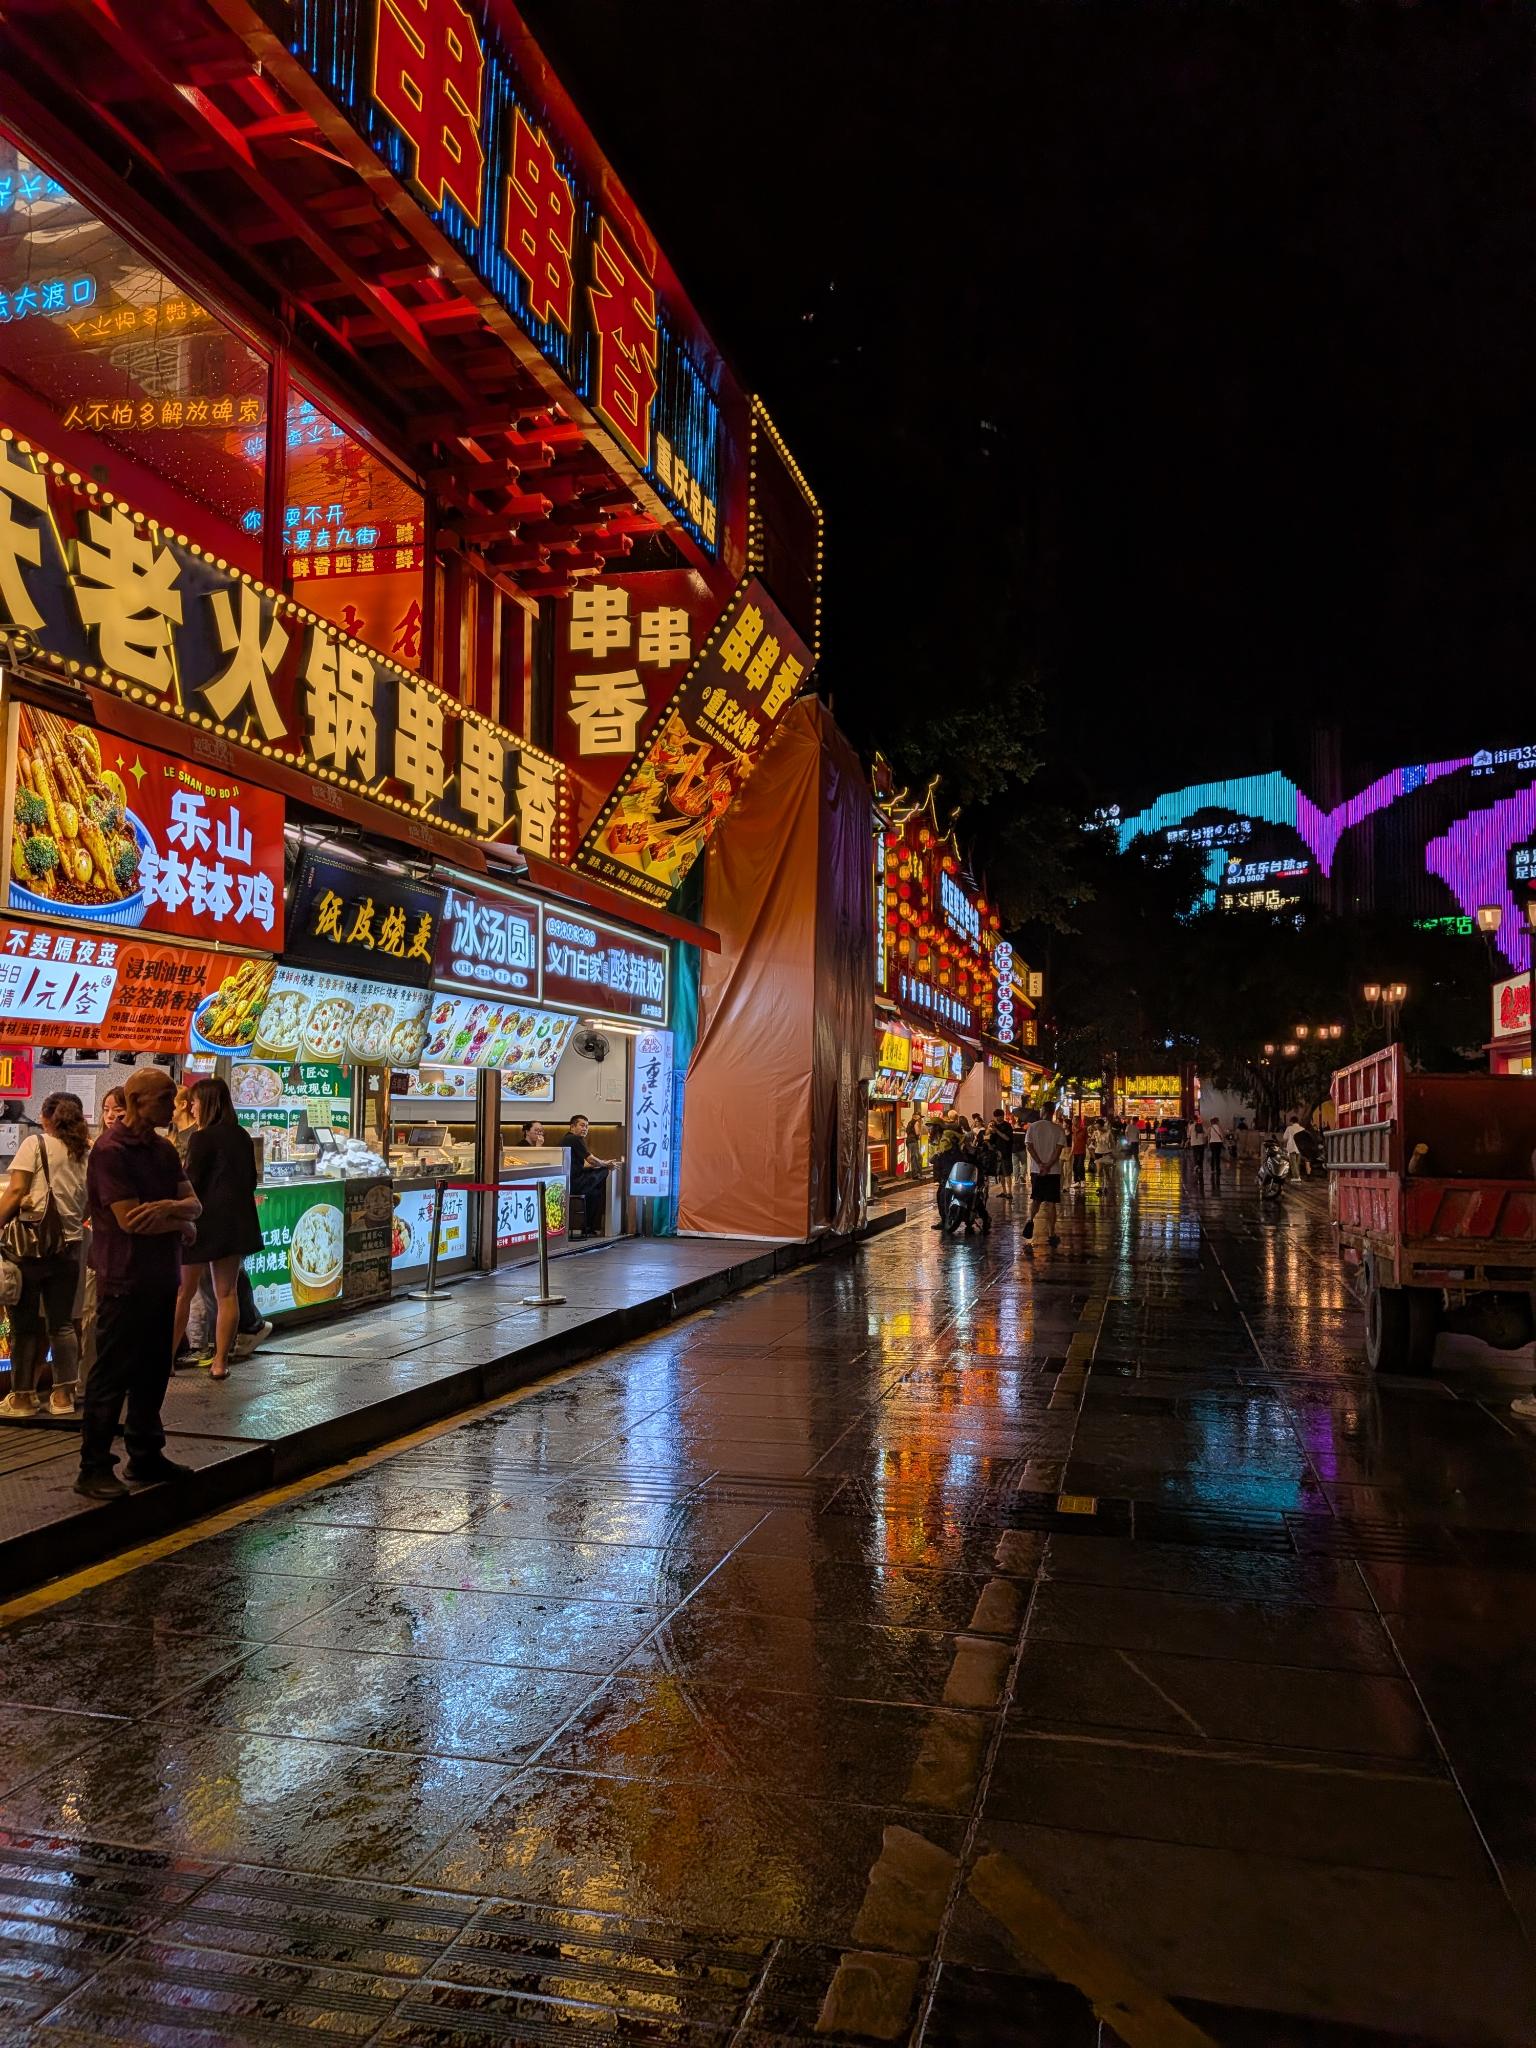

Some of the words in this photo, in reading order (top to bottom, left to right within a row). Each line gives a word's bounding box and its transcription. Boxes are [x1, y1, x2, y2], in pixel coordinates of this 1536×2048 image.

[656, 431, 717, 545] 重庆总店
[569, 585, 691, 668] 串串
[718, 603, 805, 720] 串串香
[567, 668, 648, 755] 香
[695, 715, 709, 729] ZUI
[705, 724, 717, 736] BA
[712, 730, 726, 745] DAO
[722, 739, 736, 753] HOT
[702, 687, 760, 751] 重庆火锅
[163, 766, 175, 777] LE
[178, 771, 202, 792] SHAN
[205, 787, 217, 798] BO
[219, 787, 230, 798] BO
[233, 785, 240, 798] JI
[1518, 760, 1536, 770] 637
[166, 790, 253, 866] 乐山
[1515, 849, 1536, 865] 尚
[138, 844, 275, 932] 钵钵鸡
[1227, 875, 1245, 884] 6379
[1244, 858, 1297, 877] 乐乐台球
[1296, 861, 1308, 870] 3F
[6, 928, 118, 967] 不卖隔夜菜
[451, 900, 530, 968] 冰汤圆
[0, 988, 15, 1008] 清
[607, 948, 665, 1001] 酸辣粉
[998, 942, 1013, 1043] 社区鲜货老火锅
[636, 1056, 662, 1159] 重庆小面
